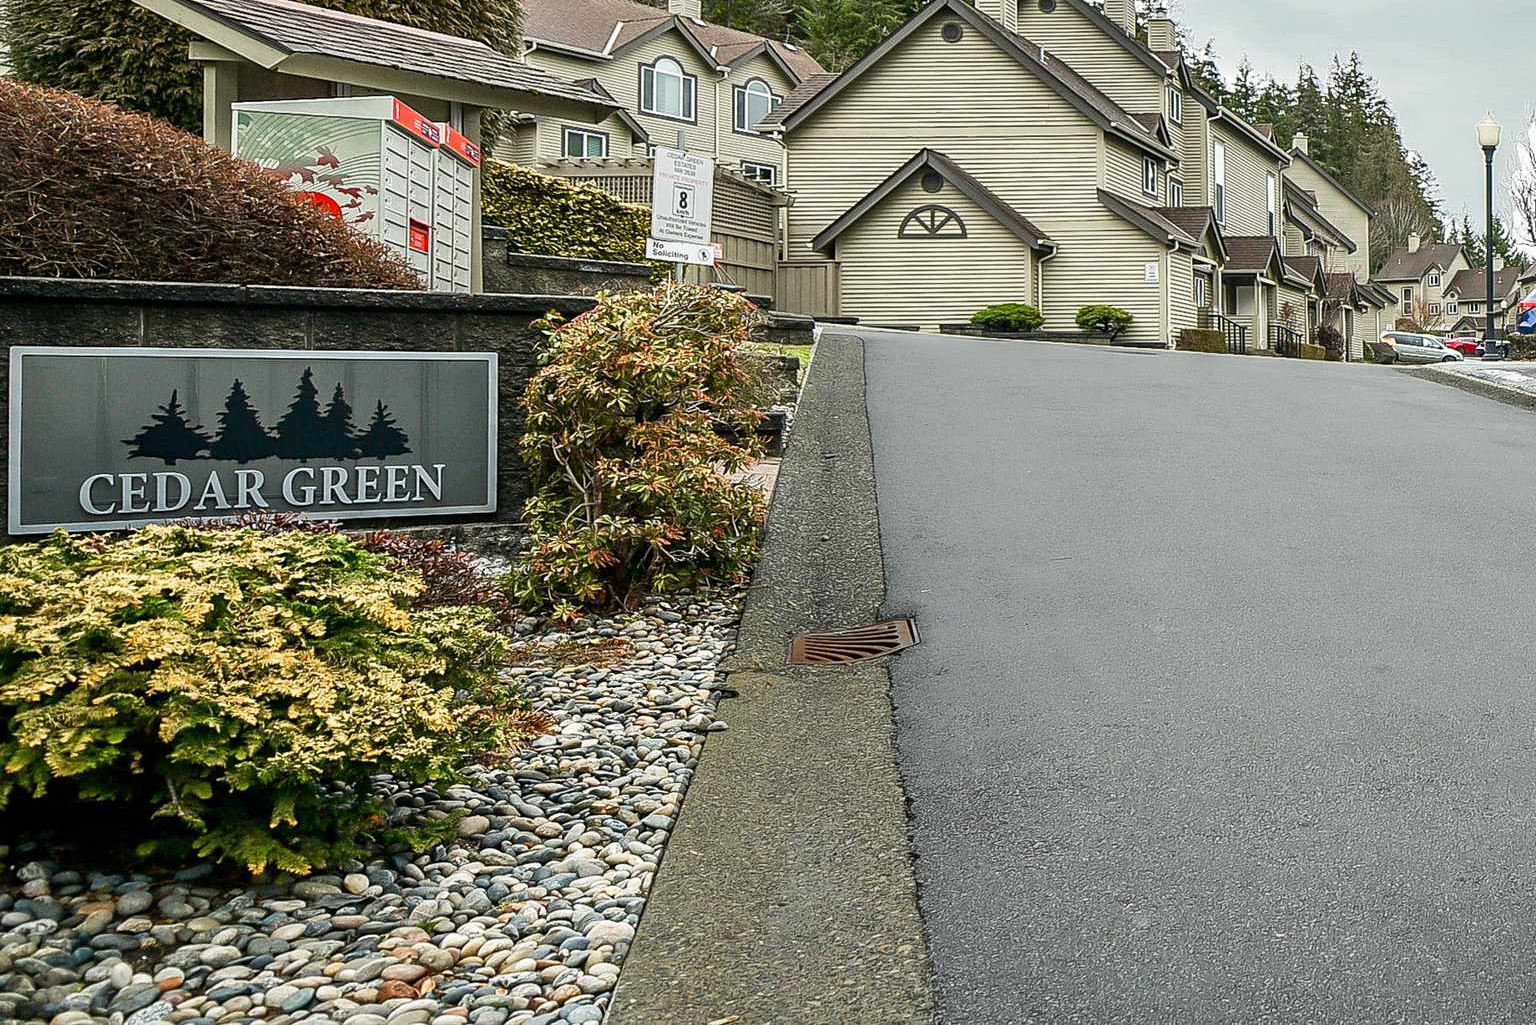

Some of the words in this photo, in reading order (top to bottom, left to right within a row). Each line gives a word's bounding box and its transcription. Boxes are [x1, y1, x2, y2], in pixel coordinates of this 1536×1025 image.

[679, 191, 688, 209] 8
[653, 241, 664, 249] No
[652, 248, 689, 261] Soliciting
[78, 469, 270, 515] CEDAR
[281, 463, 446, 506] GREEN
